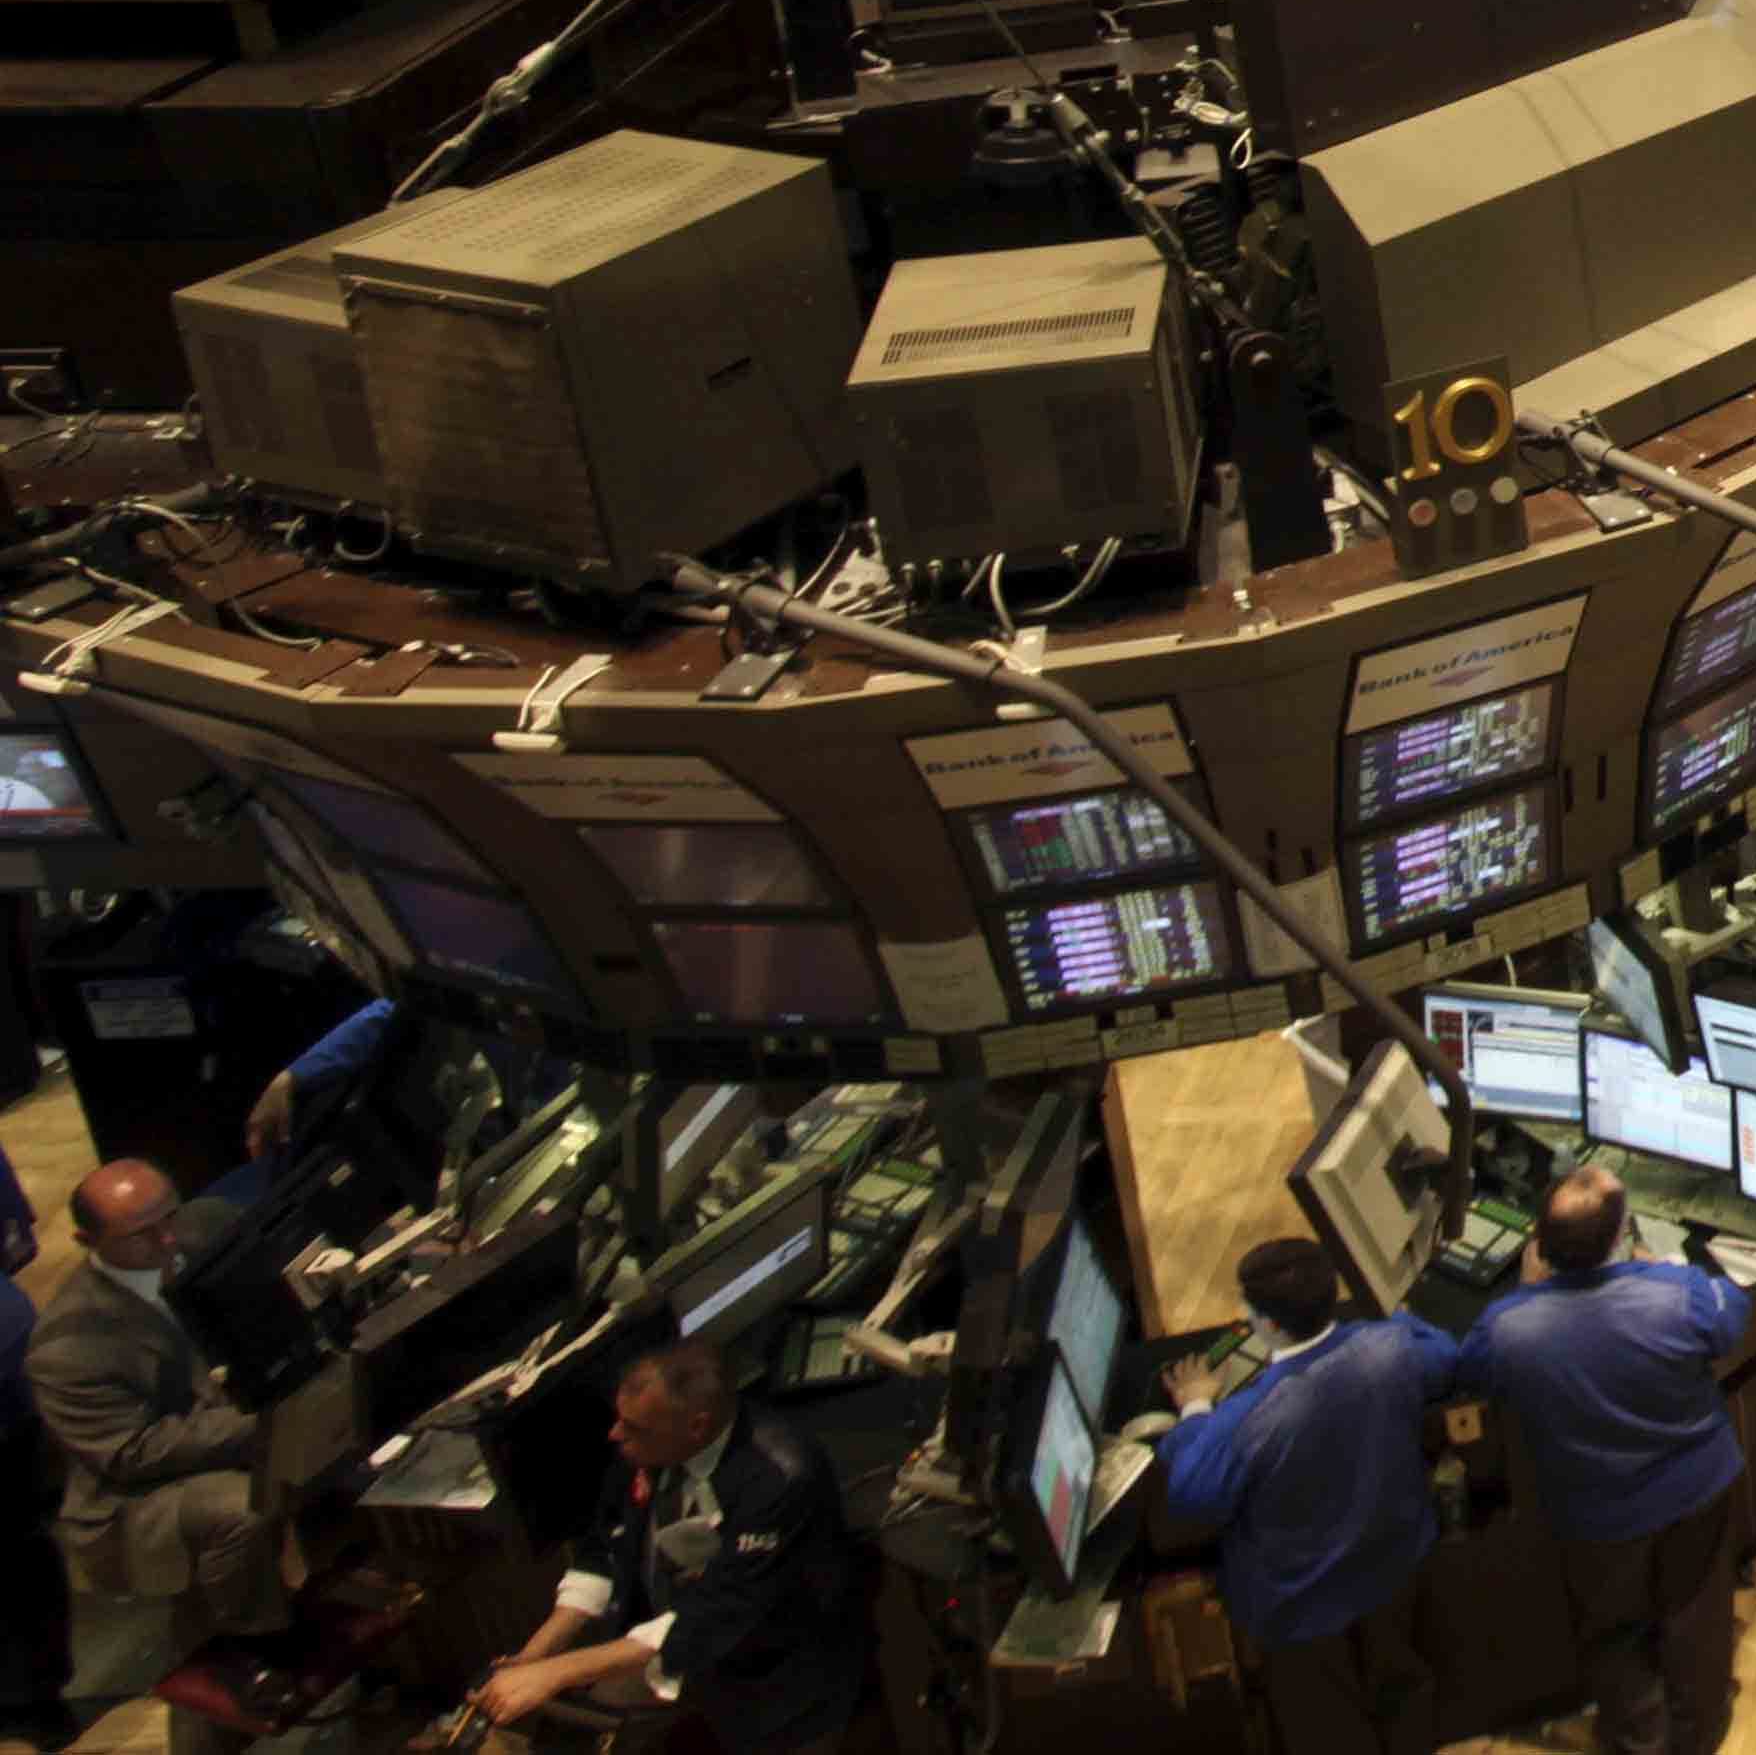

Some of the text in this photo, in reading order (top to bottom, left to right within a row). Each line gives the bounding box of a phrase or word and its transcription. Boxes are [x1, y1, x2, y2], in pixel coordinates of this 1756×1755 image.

[1393, 375, 1512, 483] 10
[1357, 625, 1576, 695] Bank of America
